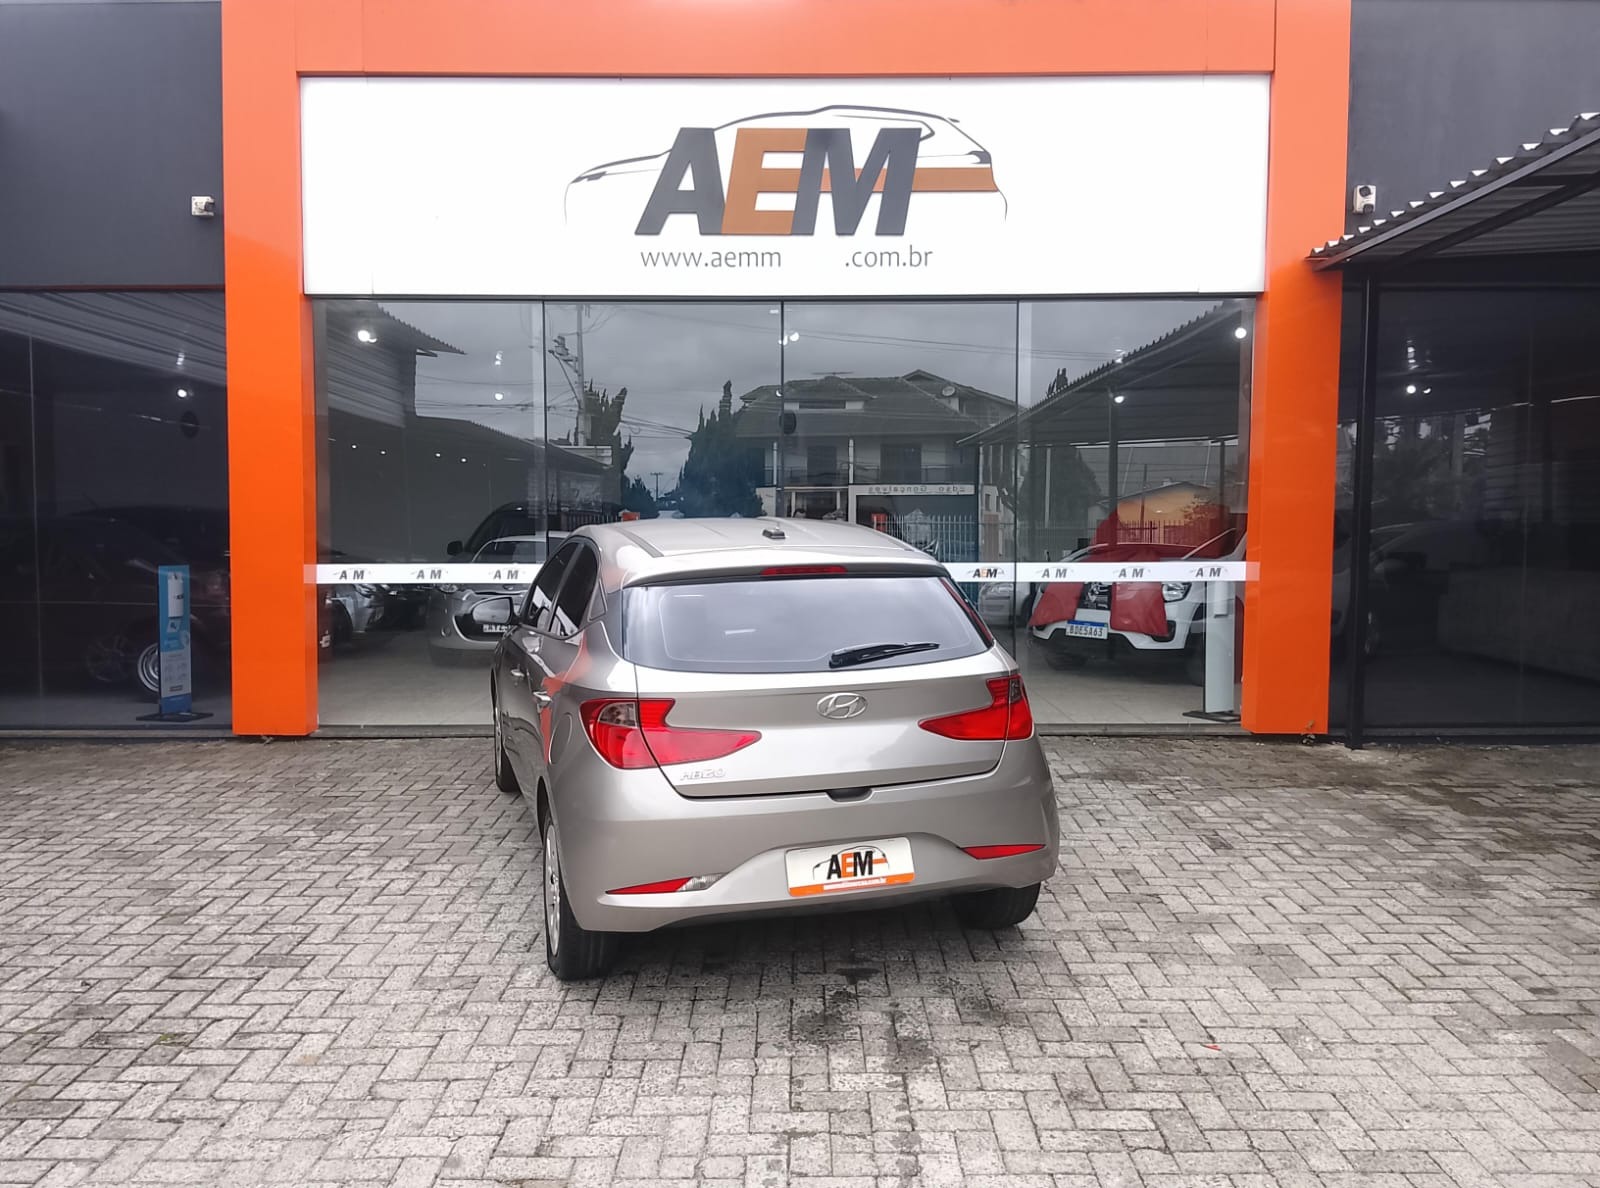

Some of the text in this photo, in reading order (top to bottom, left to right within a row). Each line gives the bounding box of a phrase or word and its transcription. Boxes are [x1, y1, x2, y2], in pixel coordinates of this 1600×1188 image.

[634, 127, 922, 236] AEM
[681, 768, 727, 781] HB20
[827, 850, 874, 880] AEM
